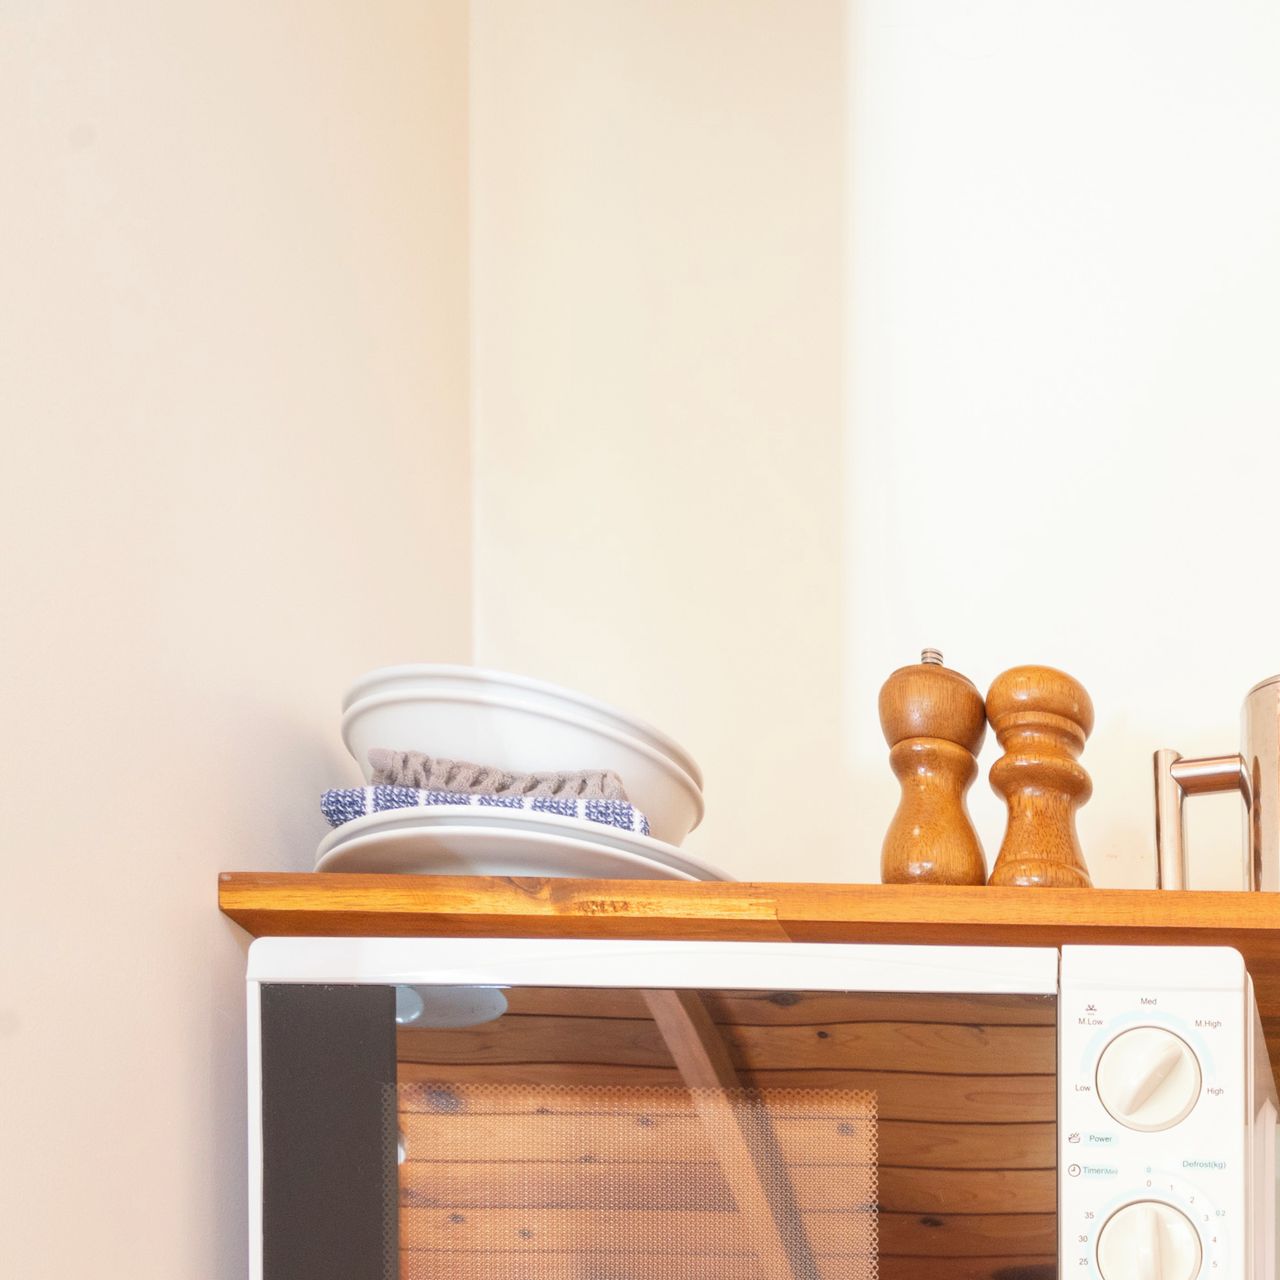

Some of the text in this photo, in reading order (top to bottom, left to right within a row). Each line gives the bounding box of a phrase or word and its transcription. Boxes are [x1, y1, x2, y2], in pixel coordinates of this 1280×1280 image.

[1140, 997, 1157, 1005] Med
[1075, 1084, 1091, 1092] Low
[1207, 1088, 1224, 1096] High
[1089, 1135, 1112, 1143] Power
[1182, 1160, 1226, 1169] Defrost(kg)
[1146, 1180, 1152, 1188] 0
[1190, 1196, 1195, 1204] 2
[1078, 1235, 1088, 1243] 30
[1079, 1258, 1088, 1266] 25
